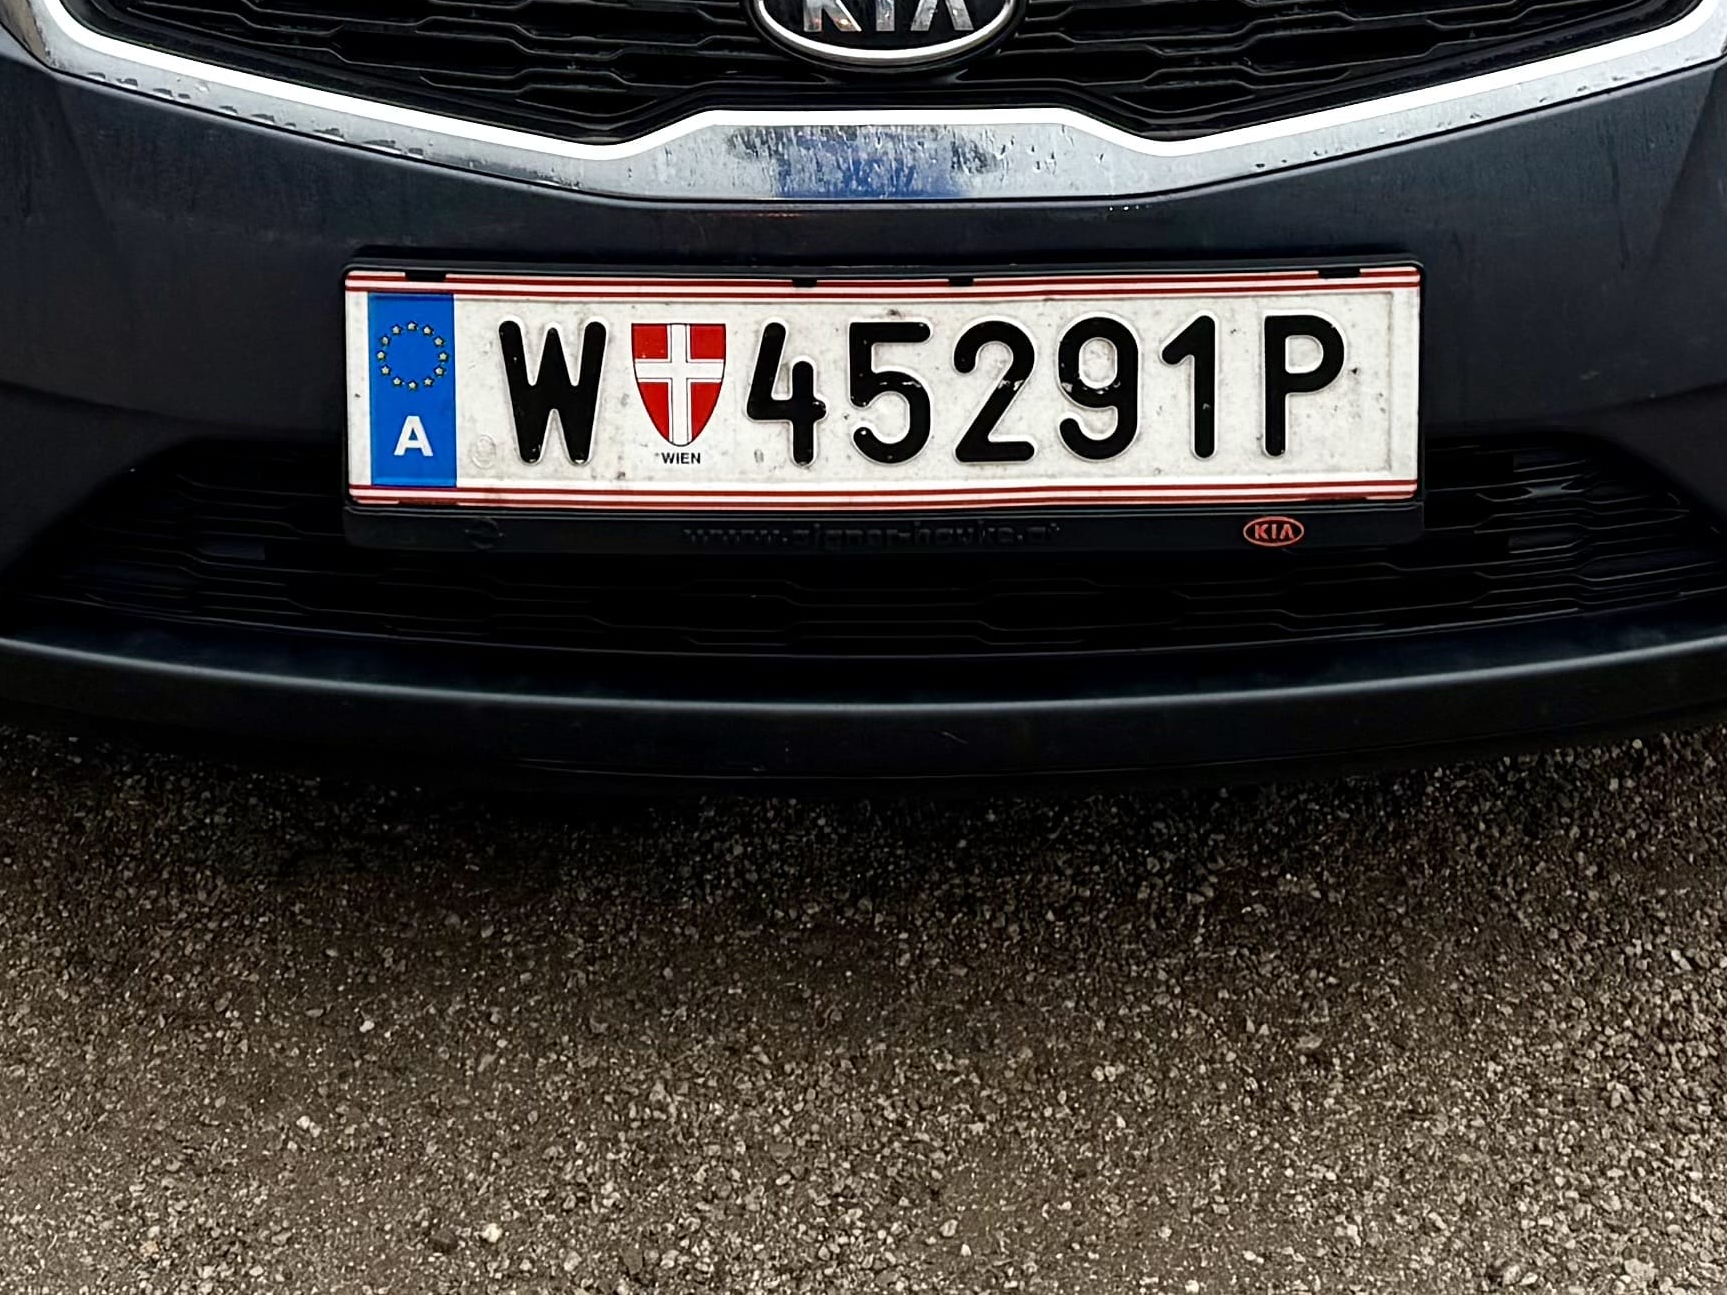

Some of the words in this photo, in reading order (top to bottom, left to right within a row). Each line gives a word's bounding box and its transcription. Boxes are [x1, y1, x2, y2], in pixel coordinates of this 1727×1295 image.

[498, 320, 607, 465] W
[746, 313, 1346, 467] 45291P
[393, 415, 434, 457] A
[661, 452, 701, 465] WIEN
[1254, 523, 1295, 540] KIA
